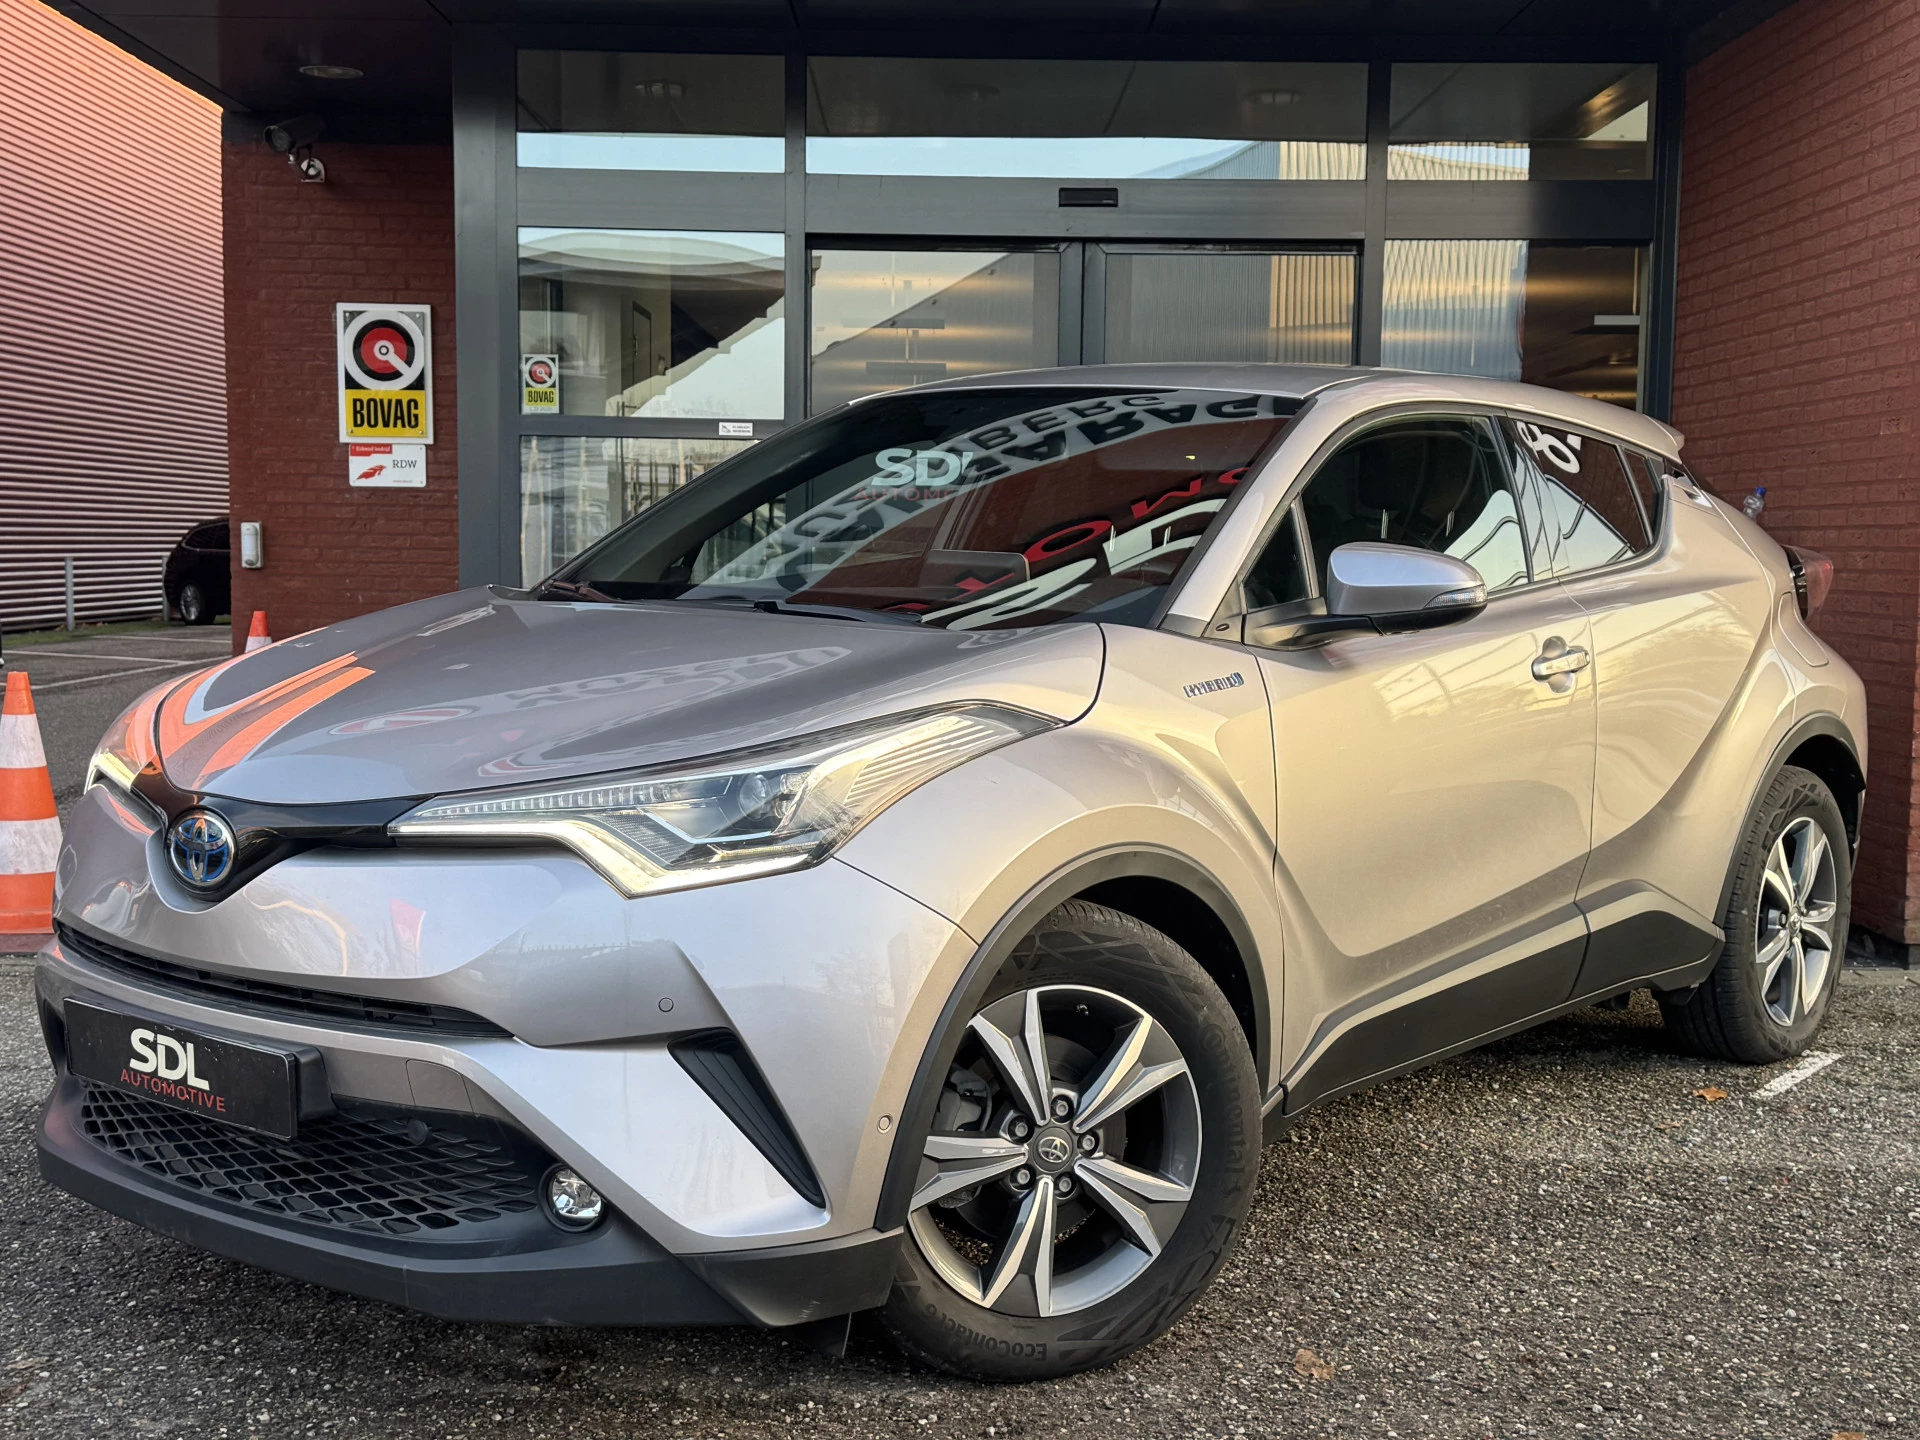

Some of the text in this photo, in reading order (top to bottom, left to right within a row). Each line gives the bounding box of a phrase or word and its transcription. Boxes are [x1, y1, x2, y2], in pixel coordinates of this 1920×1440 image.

[528, 391, 554, 403] BOVAG
[353, 398, 419, 428] BOVAG
[392, 460, 417, 469] RDW
[129, 1028, 210, 1091] SDL
[120, 1068, 226, 1112] AUTOMOTIVE
